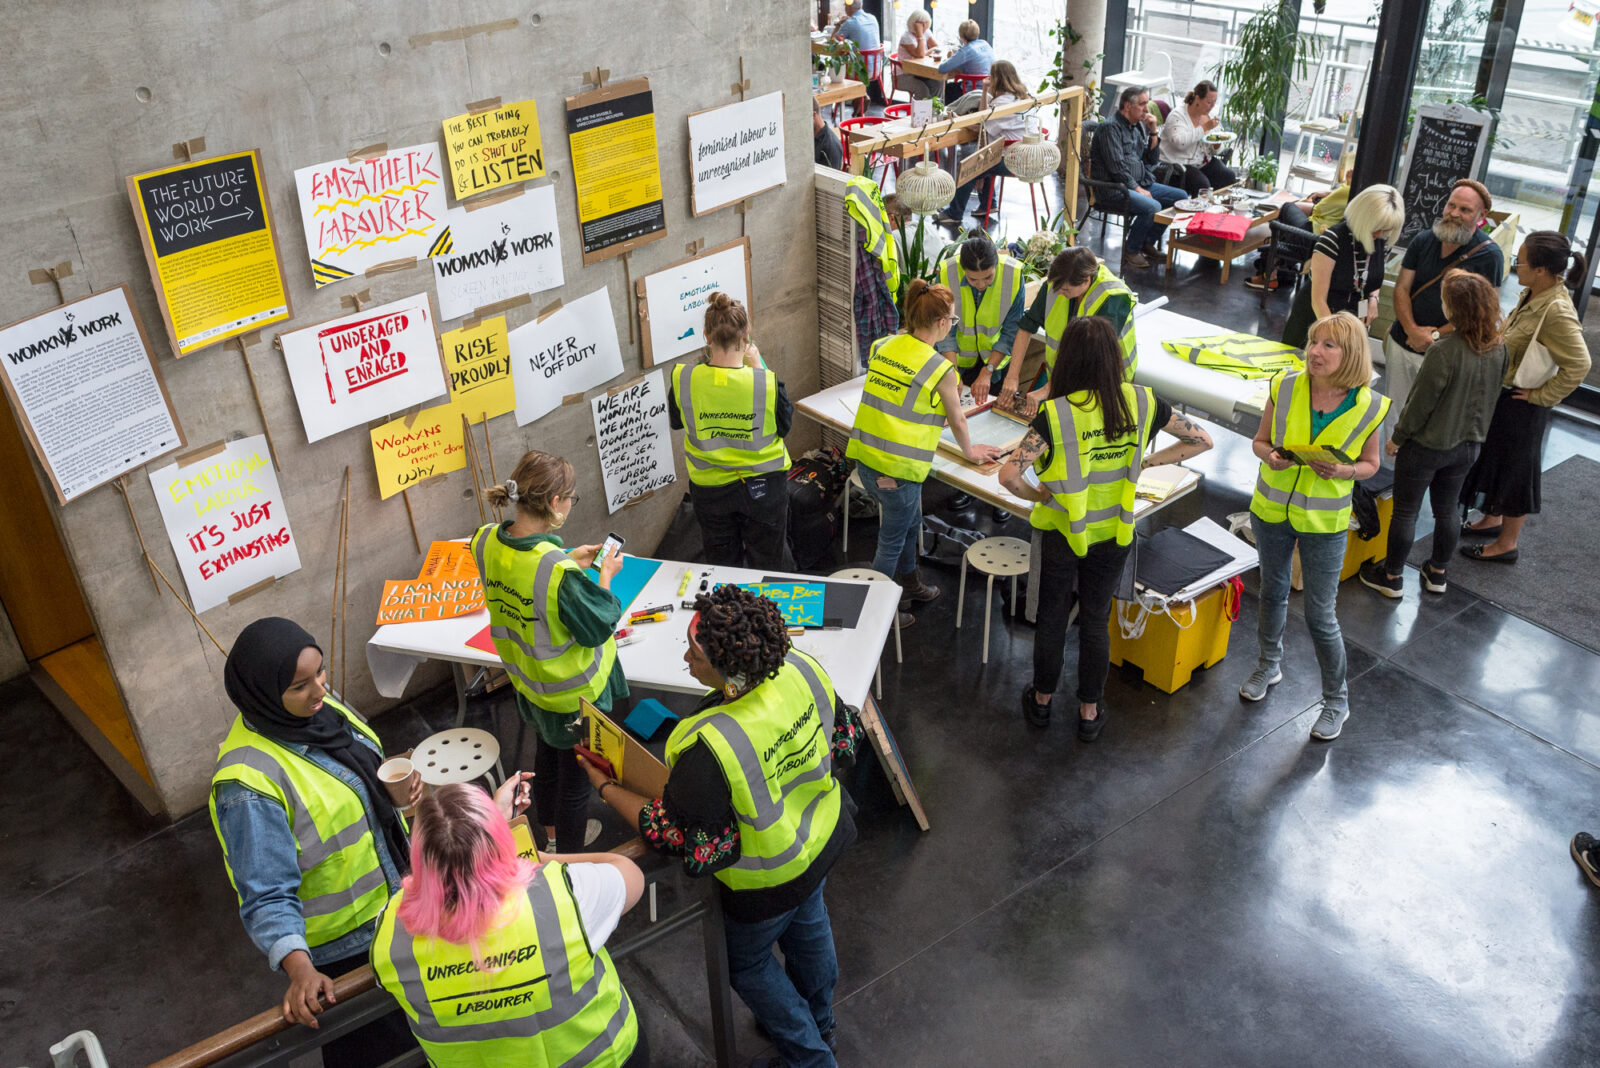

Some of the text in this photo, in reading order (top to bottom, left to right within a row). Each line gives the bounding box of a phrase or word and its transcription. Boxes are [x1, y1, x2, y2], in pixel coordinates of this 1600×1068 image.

[449, 109, 520, 135] THE BEST THING
[468, 134, 483, 148] CAN
[486, 124, 529, 143] PROBABLY
[455, 138, 527, 171] DO IS SHUT UP
[698, 121, 777, 161] feminised labour is
[471, 149, 543, 189] LISTEN
[698, 147, 779, 182] unrecognised labour
[150, 168, 247, 205] THE FUTURE
[155, 188, 242, 224] WORLD OF
[319, 189, 436, 249] LABOURER
[160, 216, 213, 243] WORK
[501, 222, 511, 236] is
[511, 232, 554, 257] WORK
[680, 281, 720, 300] EMOTIONAL
[64, 312, 75, 322] is
[78, 312, 122, 337] WORK
[330, 315, 409, 353] UNDERAGED
[454, 333, 498, 363] RISE
[360, 339, 391, 363] AND
[529, 336, 578, 372] NEVER
[544, 343, 596, 379] OFF DUTY
[345, 352, 406, 386] ENRAGED
[450, 355, 510, 391] PROUDLY
[598, 381, 651, 414] WE ARE
[600, 403, 666, 437] WE WANT OUR
[699, 411, 757, 421] UNRECOGNISED
[711, 430, 751, 440] LABOURER
[411, 443, 464, 464] never done
[607, 456, 651, 479] FEMINIST
[168, 451, 270, 505] EMOTIONAL
[620, 460, 657, 484] LABOUR
[194, 479, 263, 518] LABOUR
[611, 474, 675, 507] RECOGNISED
[186, 501, 272, 554] IT'S JUST
[198, 526, 291, 581] EXHAUSTING
[385, 589, 483, 606] DEFINED B
[390, 577, 481, 595] I AM NOT
[380, 600, 485, 621] WHAT I DO!
[427, 944, 538, 981] UNRECOGNISED
[456, 991, 535, 1016] LABOURER
